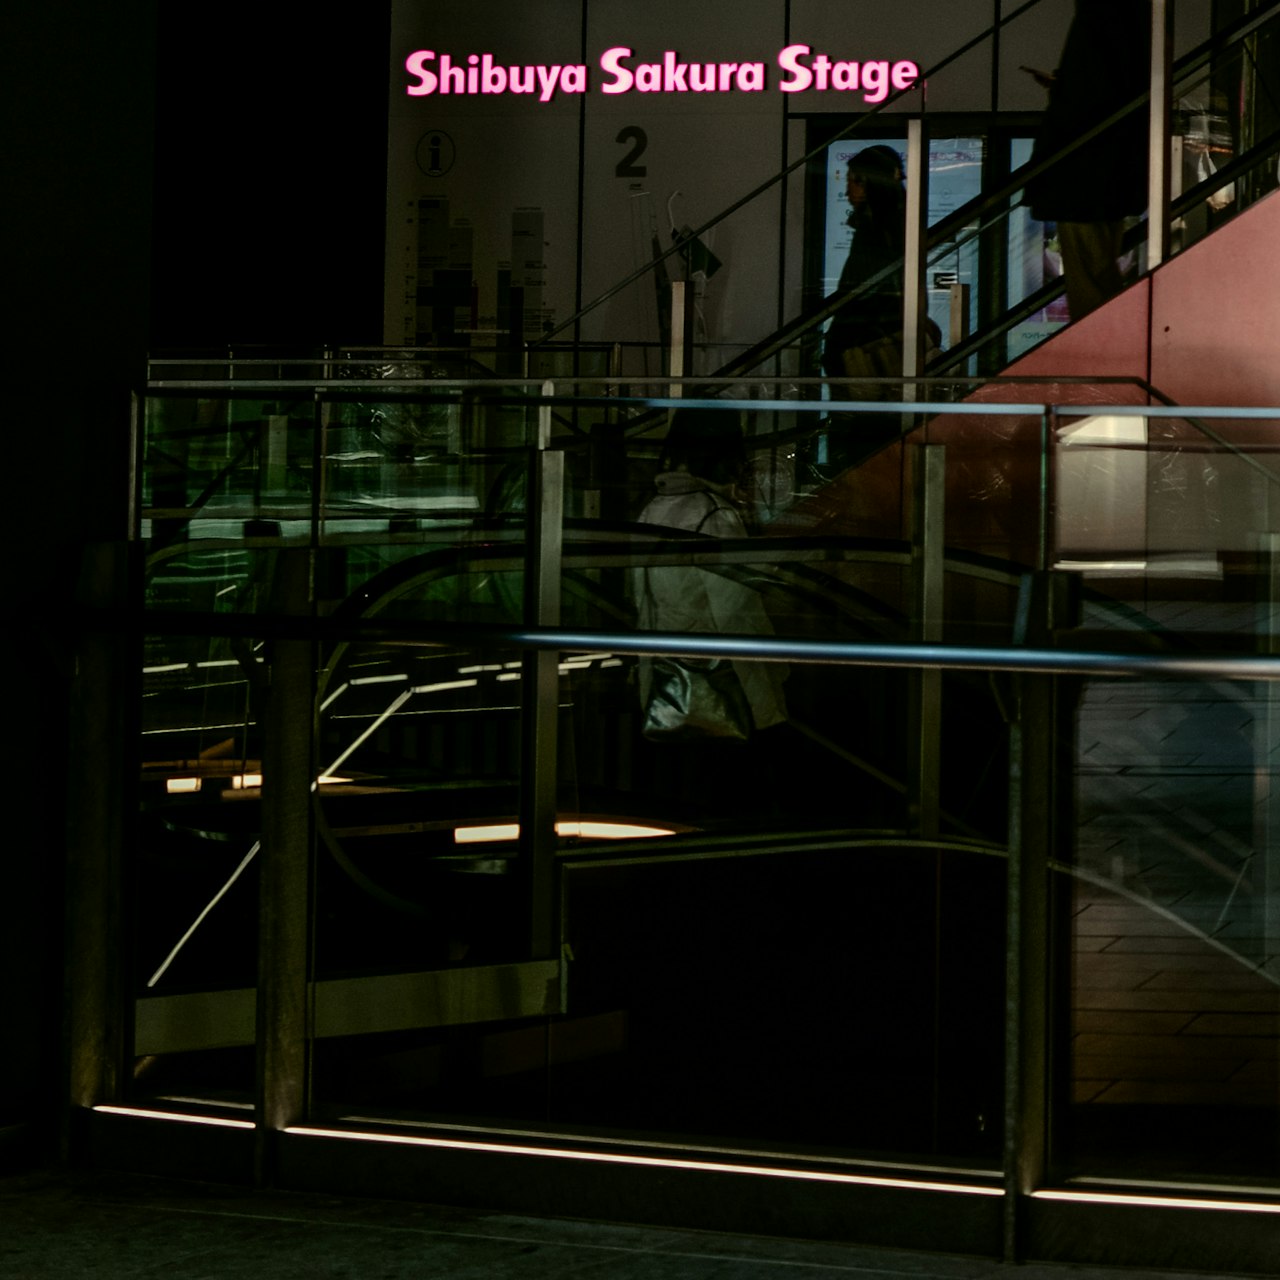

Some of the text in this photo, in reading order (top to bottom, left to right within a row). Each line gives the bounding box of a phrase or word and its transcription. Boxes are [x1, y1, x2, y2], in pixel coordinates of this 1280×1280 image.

[404, 43, 919, 103] Shibuya Sakura Stage
[614, 125, 649, 178] 2
